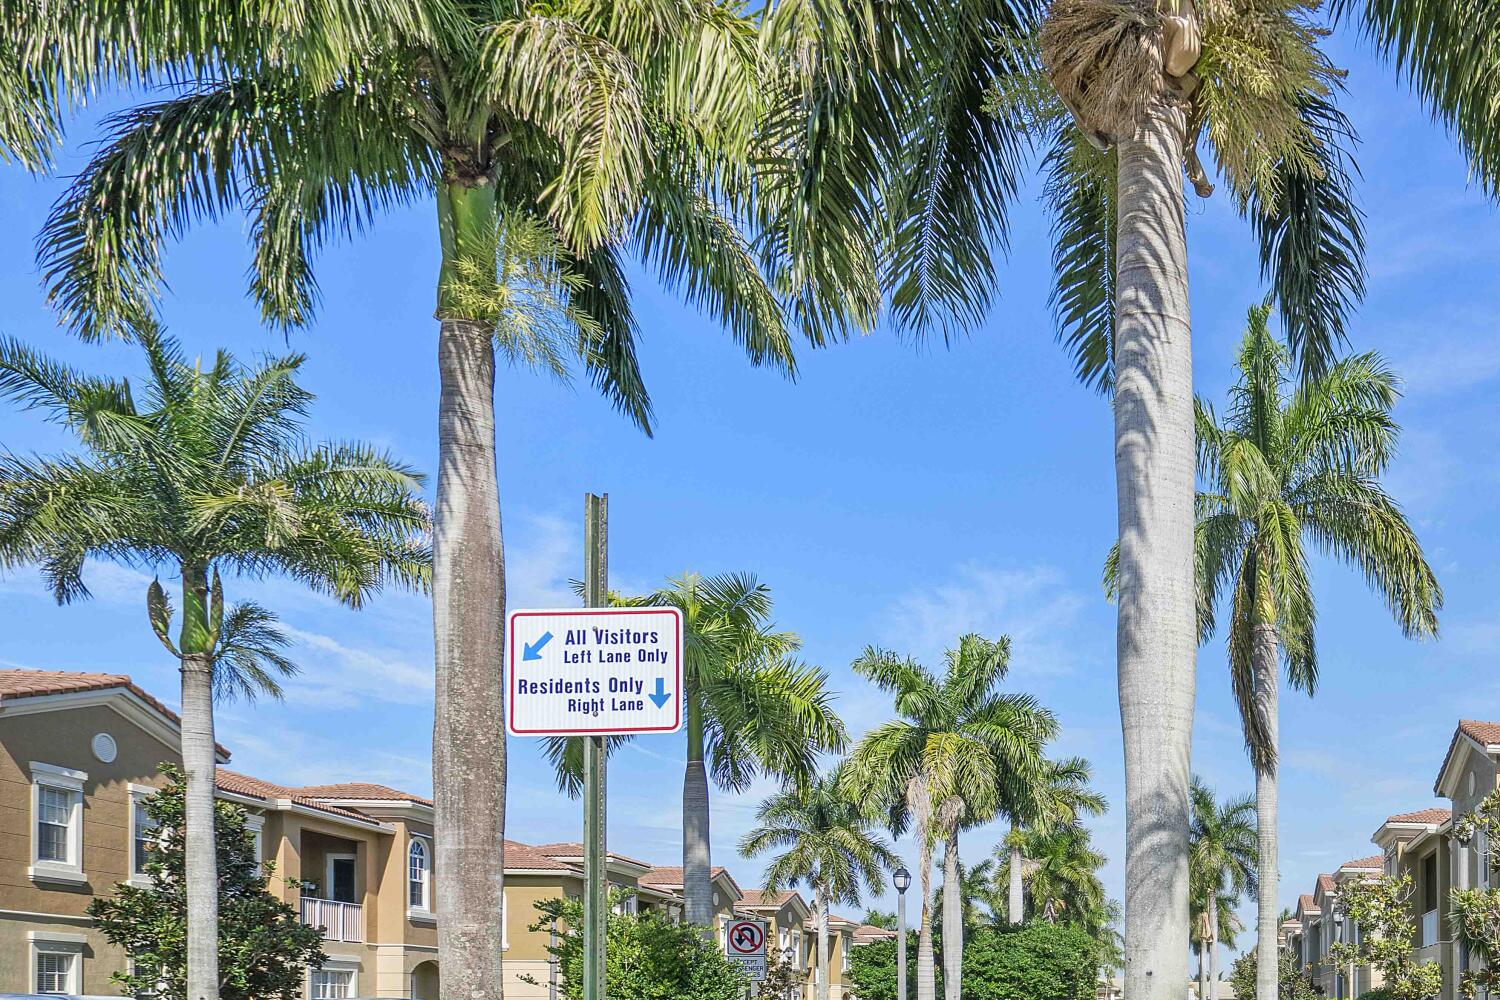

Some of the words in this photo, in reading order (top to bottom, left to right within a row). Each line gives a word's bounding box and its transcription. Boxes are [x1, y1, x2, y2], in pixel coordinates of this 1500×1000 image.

[565, 629, 586, 645] All
[595, 629, 659, 645] Visitors
[564, 650, 592, 664] Left
[599, 650, 631, 663] Lane
[638, 648, 668, 664] Only
[518, 678, 600, 694] Residents
[609, 677, 644, 695] Only
[568, 698, 605, 715] Right
[611, 698, 644, 711] Lane
